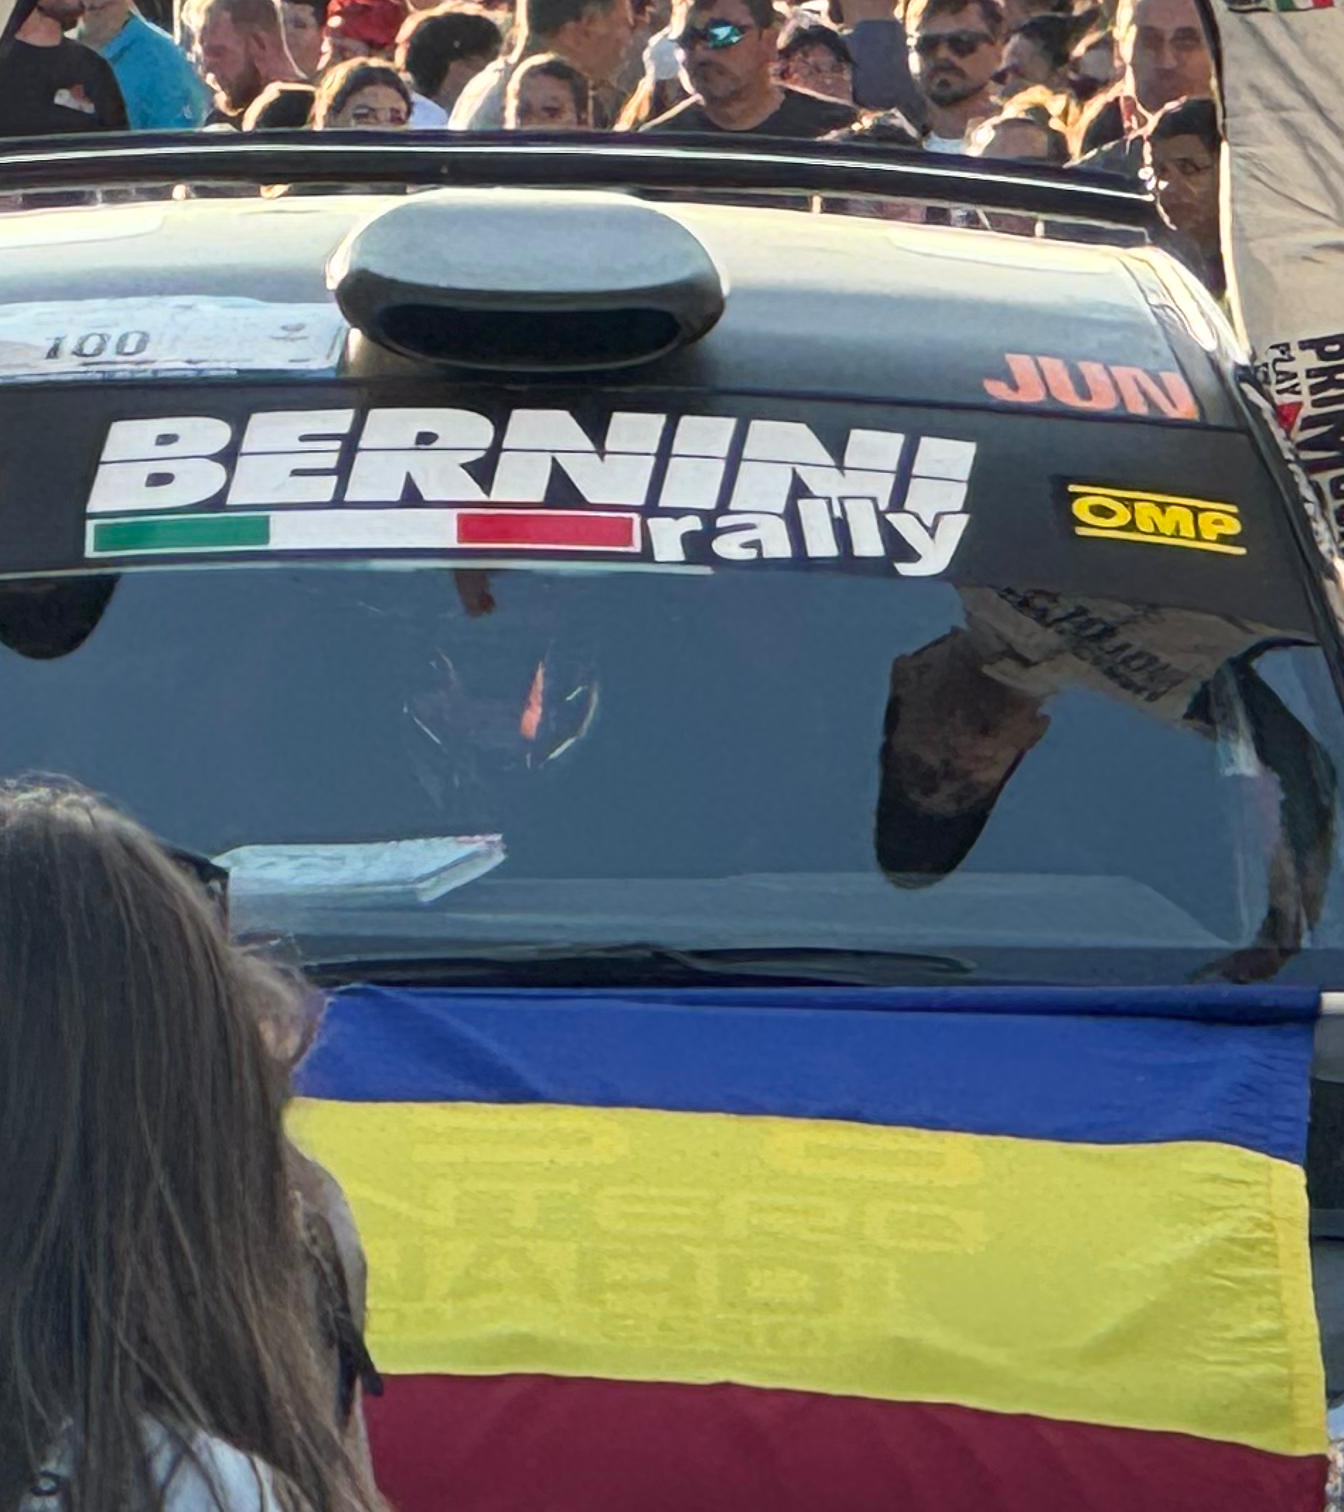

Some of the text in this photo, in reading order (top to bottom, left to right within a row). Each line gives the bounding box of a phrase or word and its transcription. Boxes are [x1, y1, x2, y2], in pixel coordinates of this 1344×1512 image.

[45, 329, 151, 360] 100
[85, 407, 977, 520] BERNINI
[647, 495, 971, 577] rally
[1070, 492, 1244, 543] OMP
